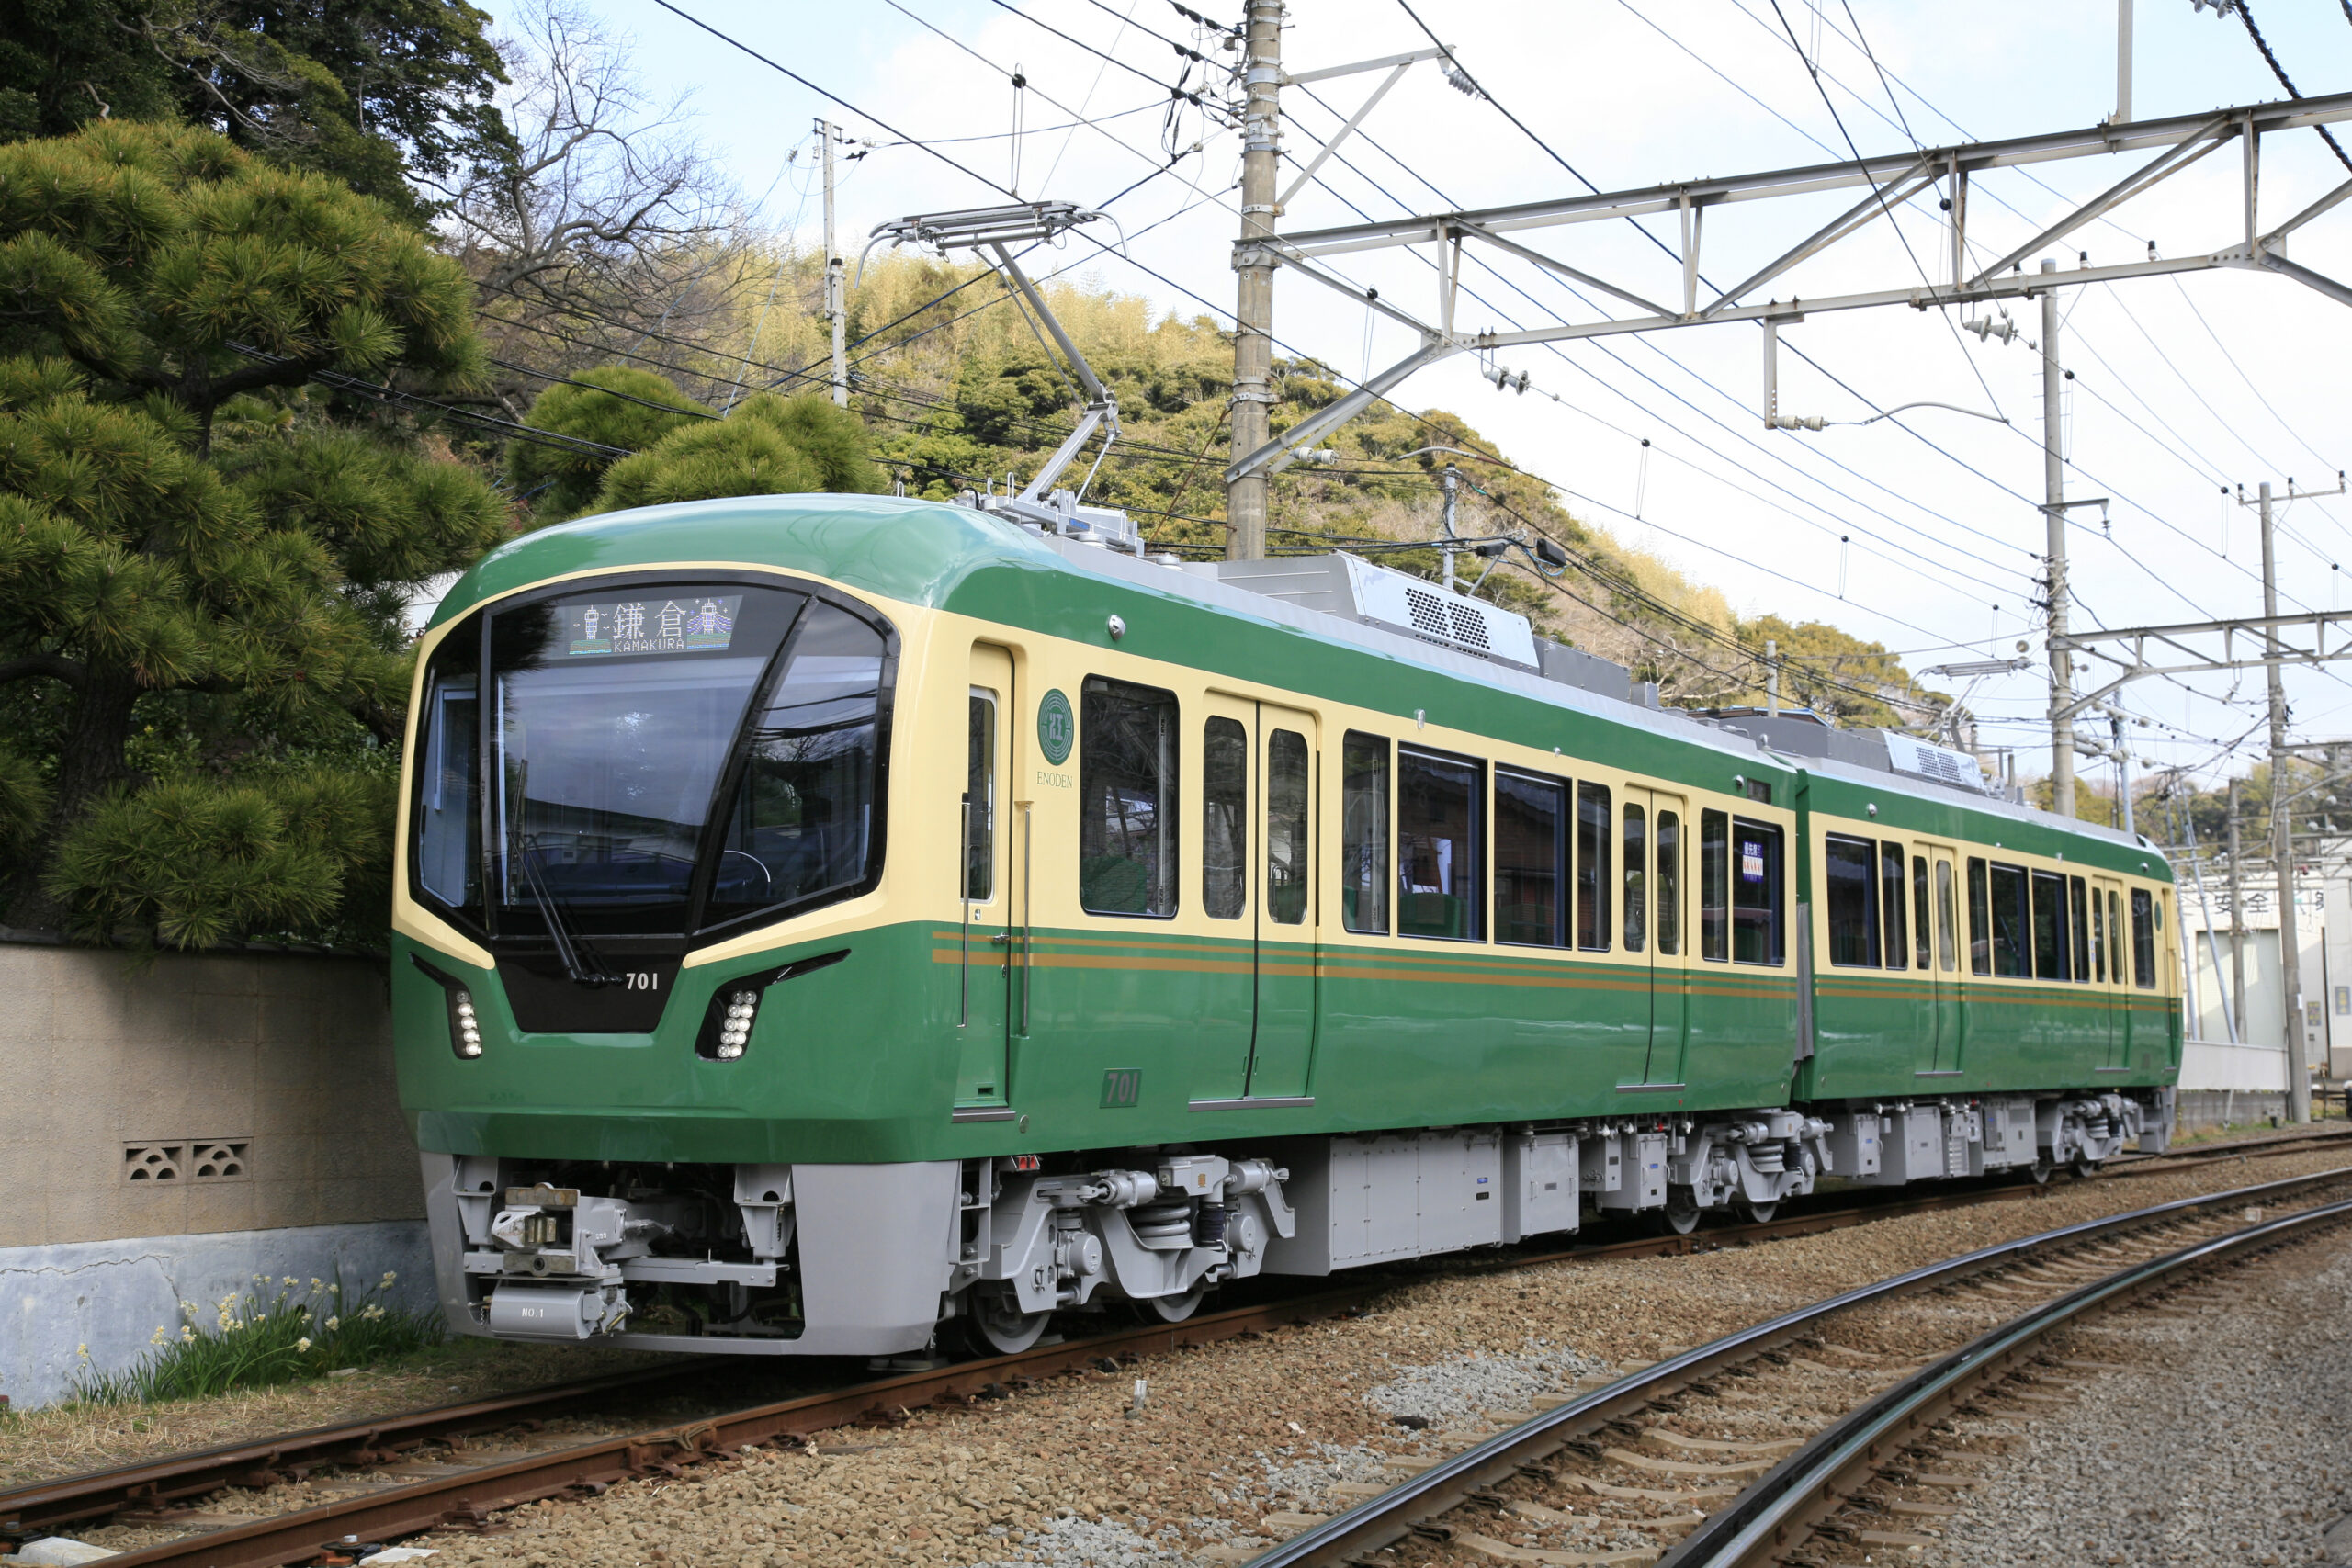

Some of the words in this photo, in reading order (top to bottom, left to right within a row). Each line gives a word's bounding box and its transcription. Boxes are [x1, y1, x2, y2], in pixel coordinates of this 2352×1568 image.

[612, 600, 687, 640] 鎌倉
[614, 638, 684, 653] KAMAKURA
[1036, 771, 1073, 789] ENODEN
[626, 972, 658, 990] 701
[1106, 1072, 1139, 1103] 701
[521, 1307, 544, 1318] NO.1
